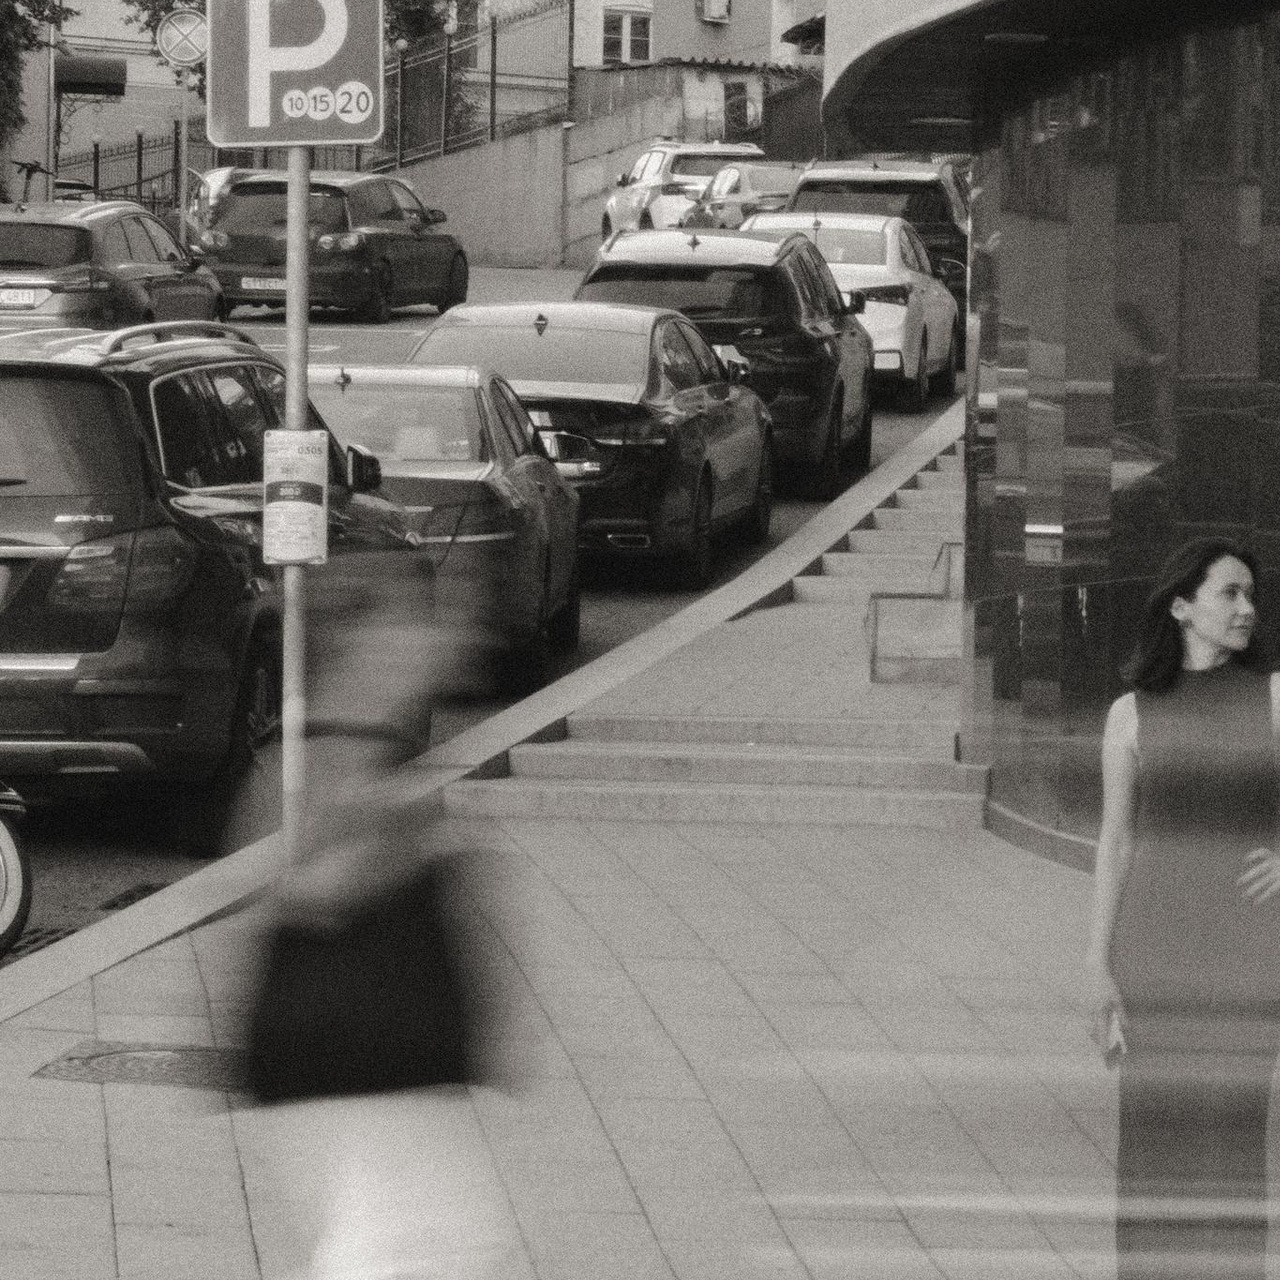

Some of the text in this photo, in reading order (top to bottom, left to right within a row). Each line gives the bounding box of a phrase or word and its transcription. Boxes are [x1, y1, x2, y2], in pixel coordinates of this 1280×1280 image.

[288, 90, 370, 114] 10 15 20
